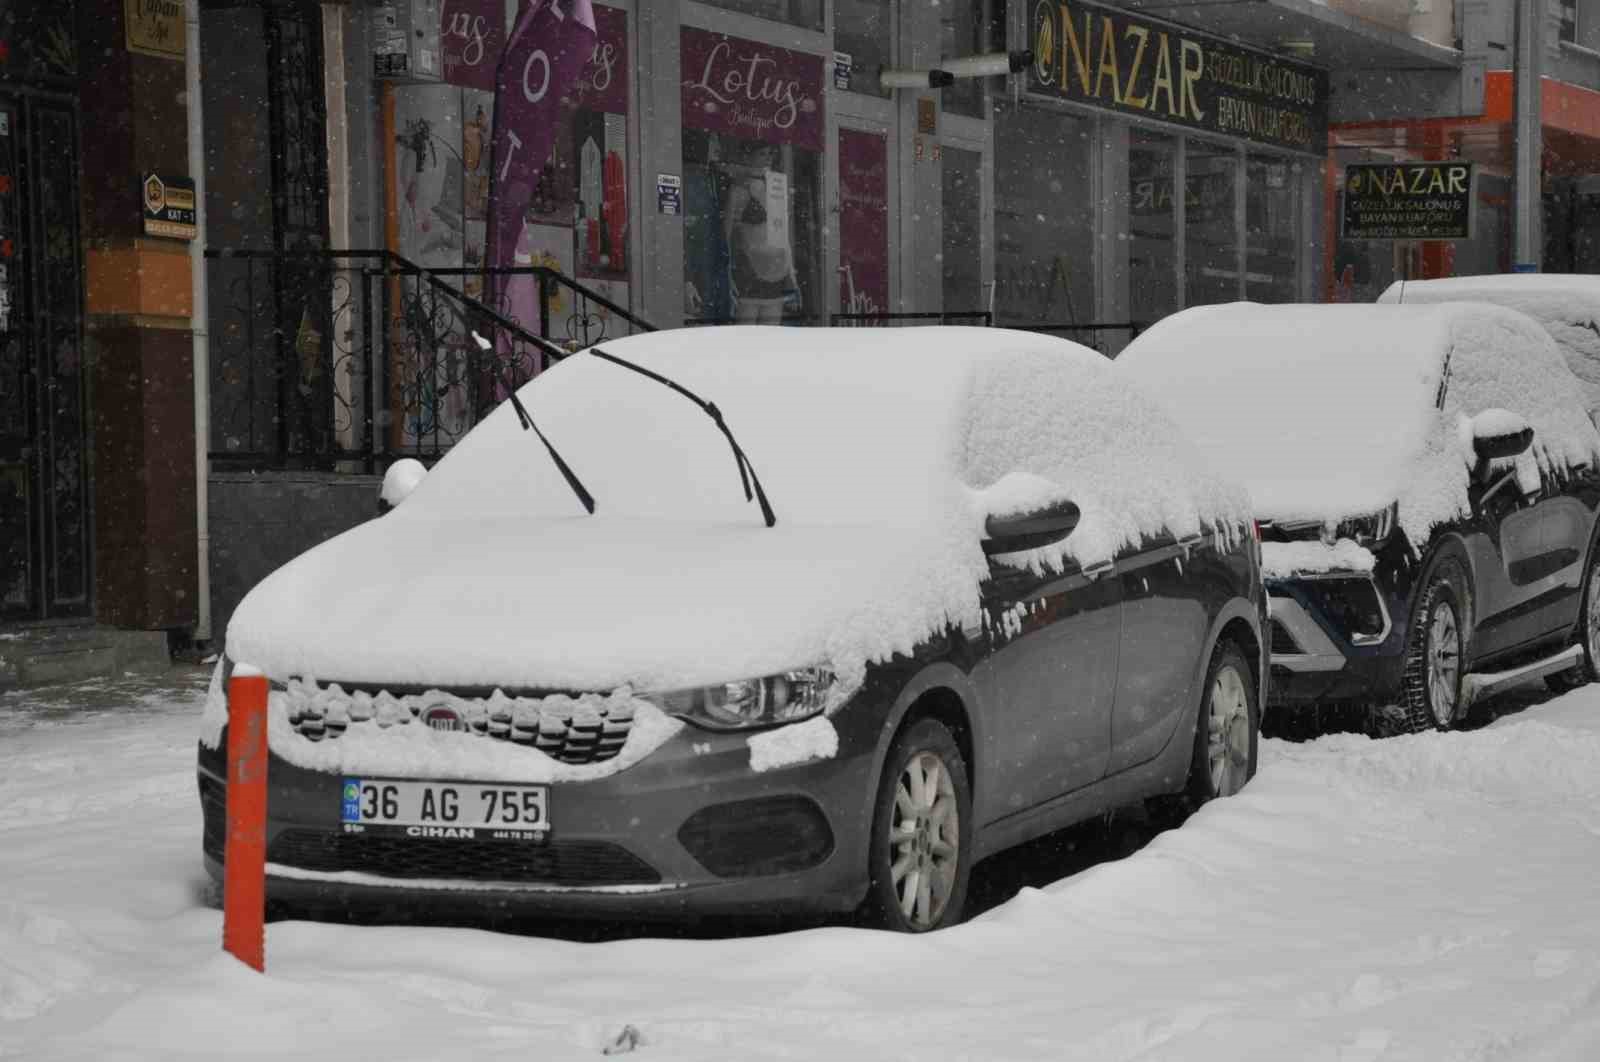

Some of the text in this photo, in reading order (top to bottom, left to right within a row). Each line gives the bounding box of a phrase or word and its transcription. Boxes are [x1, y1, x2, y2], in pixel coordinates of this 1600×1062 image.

[1060, 2, 1205, 121] NAZAR
[681, 42, 811, 128] Lotus
[1218, 96, 1256, 133] BAYAN
[1367, 167, 1467, 194] NAZAR
[345, 785, 541, 824] TR 36 AG 755
